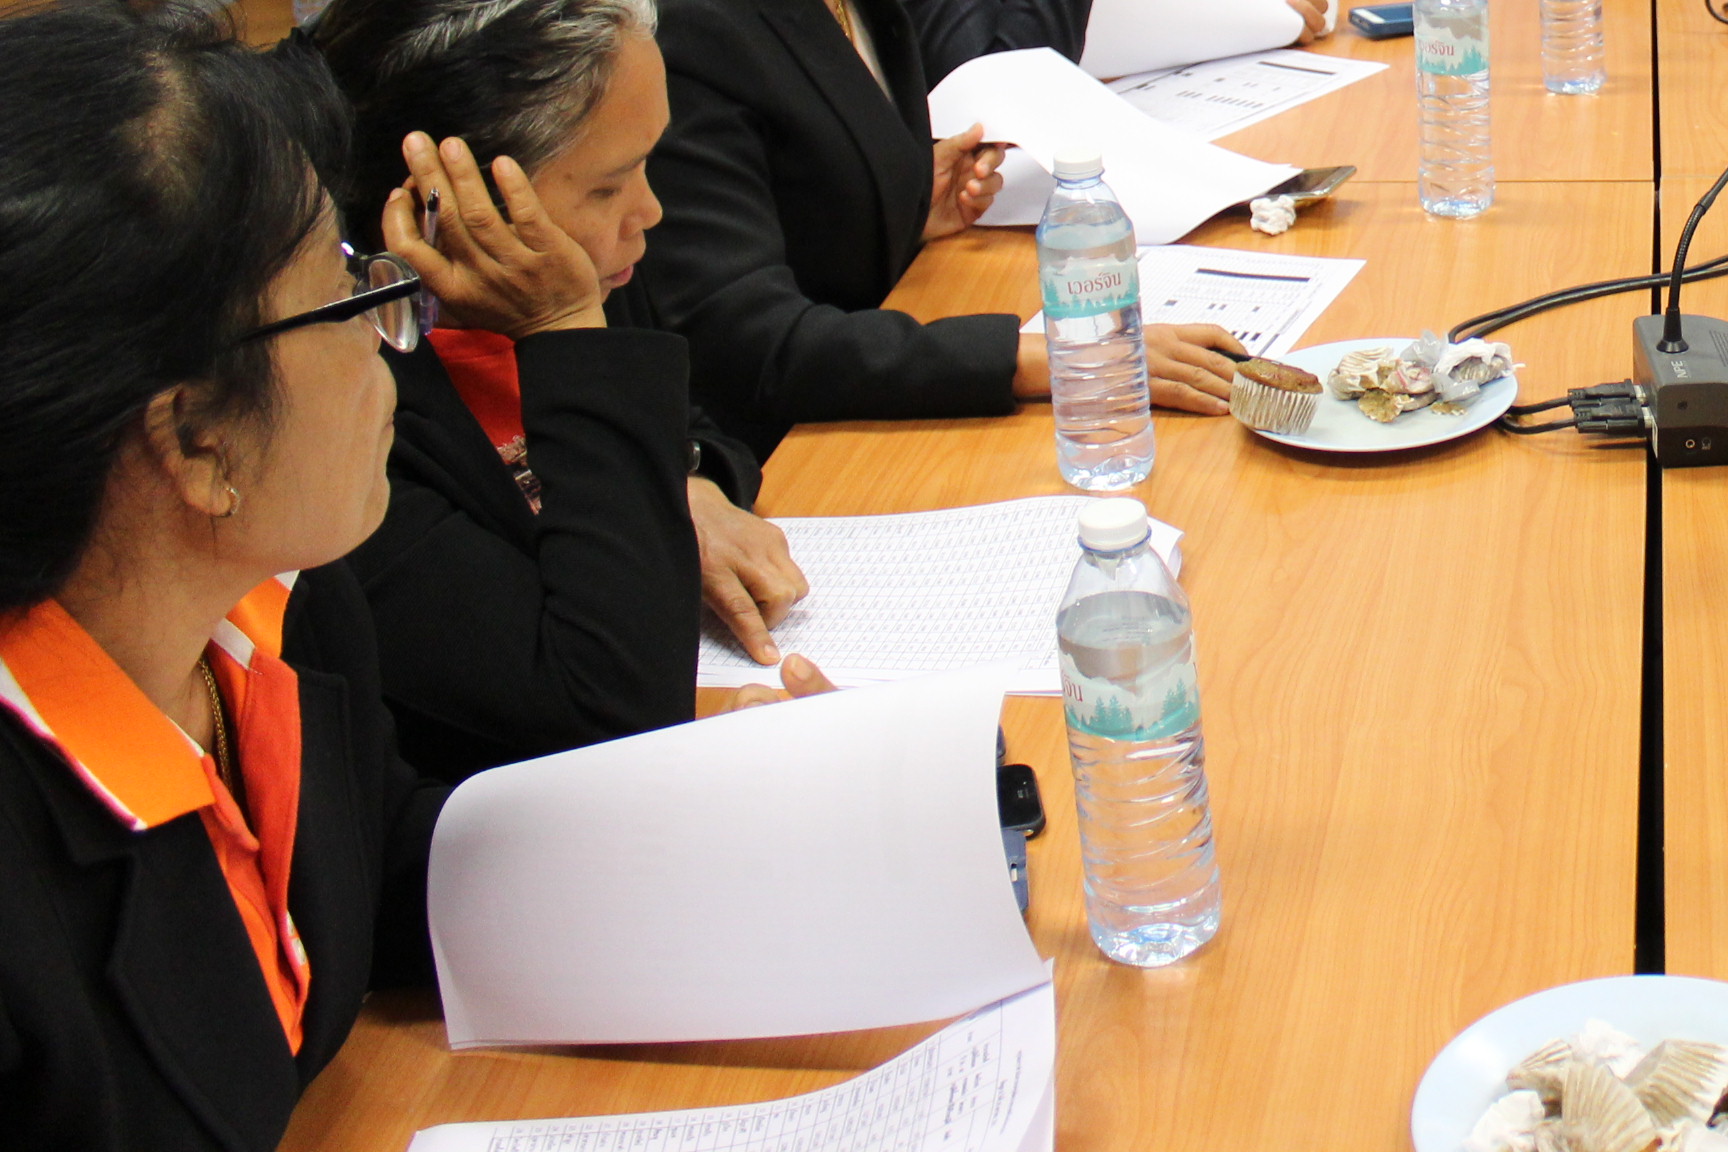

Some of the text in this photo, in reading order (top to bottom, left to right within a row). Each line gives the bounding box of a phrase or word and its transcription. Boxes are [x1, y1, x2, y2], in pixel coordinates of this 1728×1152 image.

[1067, 271, 1122, 295] เวอร์จิน
[1670, 359, 1689, 379] NPE
